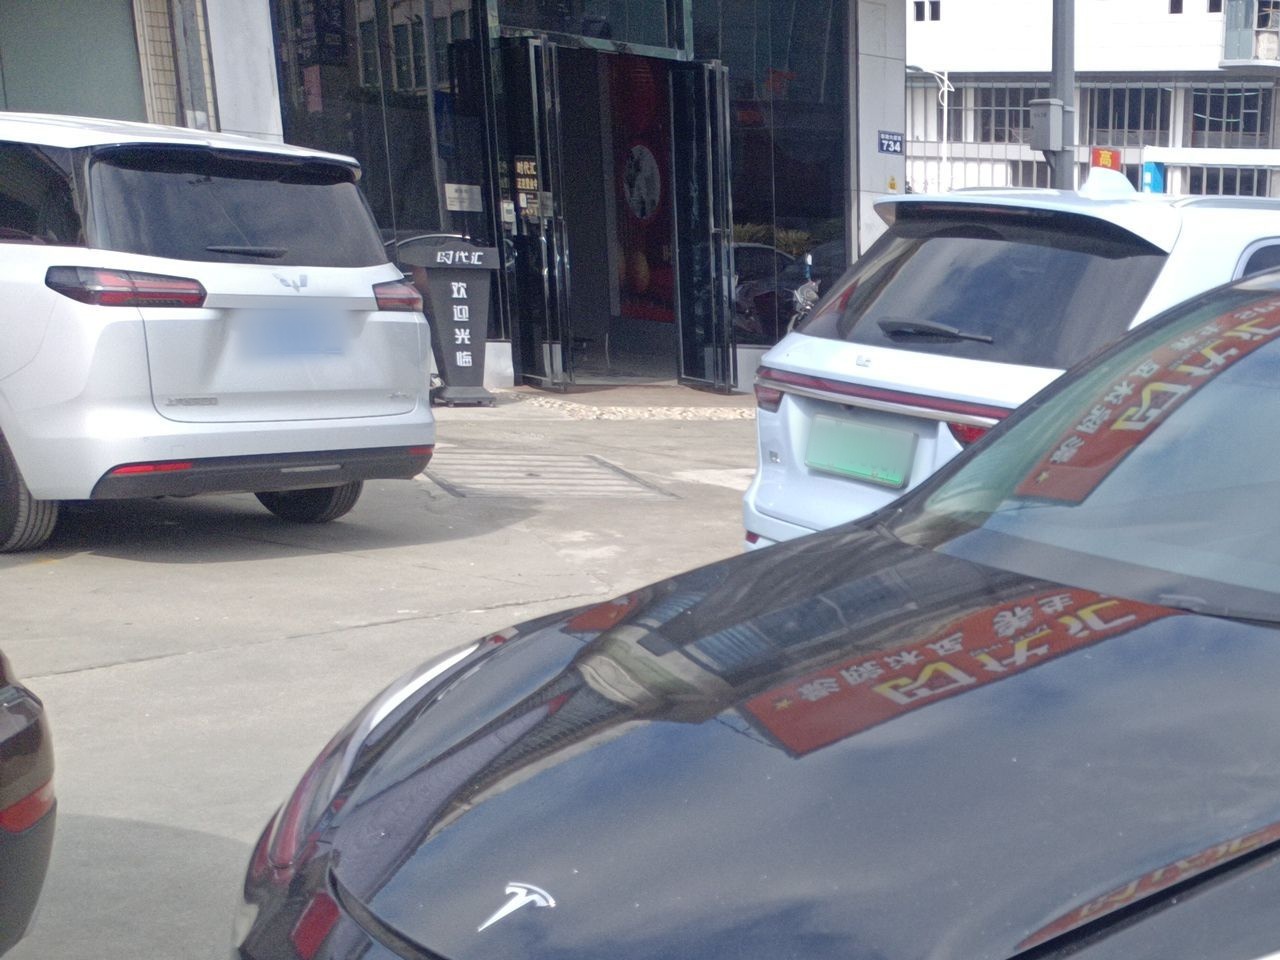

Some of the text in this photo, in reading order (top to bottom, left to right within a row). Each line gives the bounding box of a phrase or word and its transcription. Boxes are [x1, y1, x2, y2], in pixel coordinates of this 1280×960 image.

[881, 140, 901, 152] 734
[436, 250, 484, 265] 时代汇
[451, 281, 473, 367] 欢迎光临
